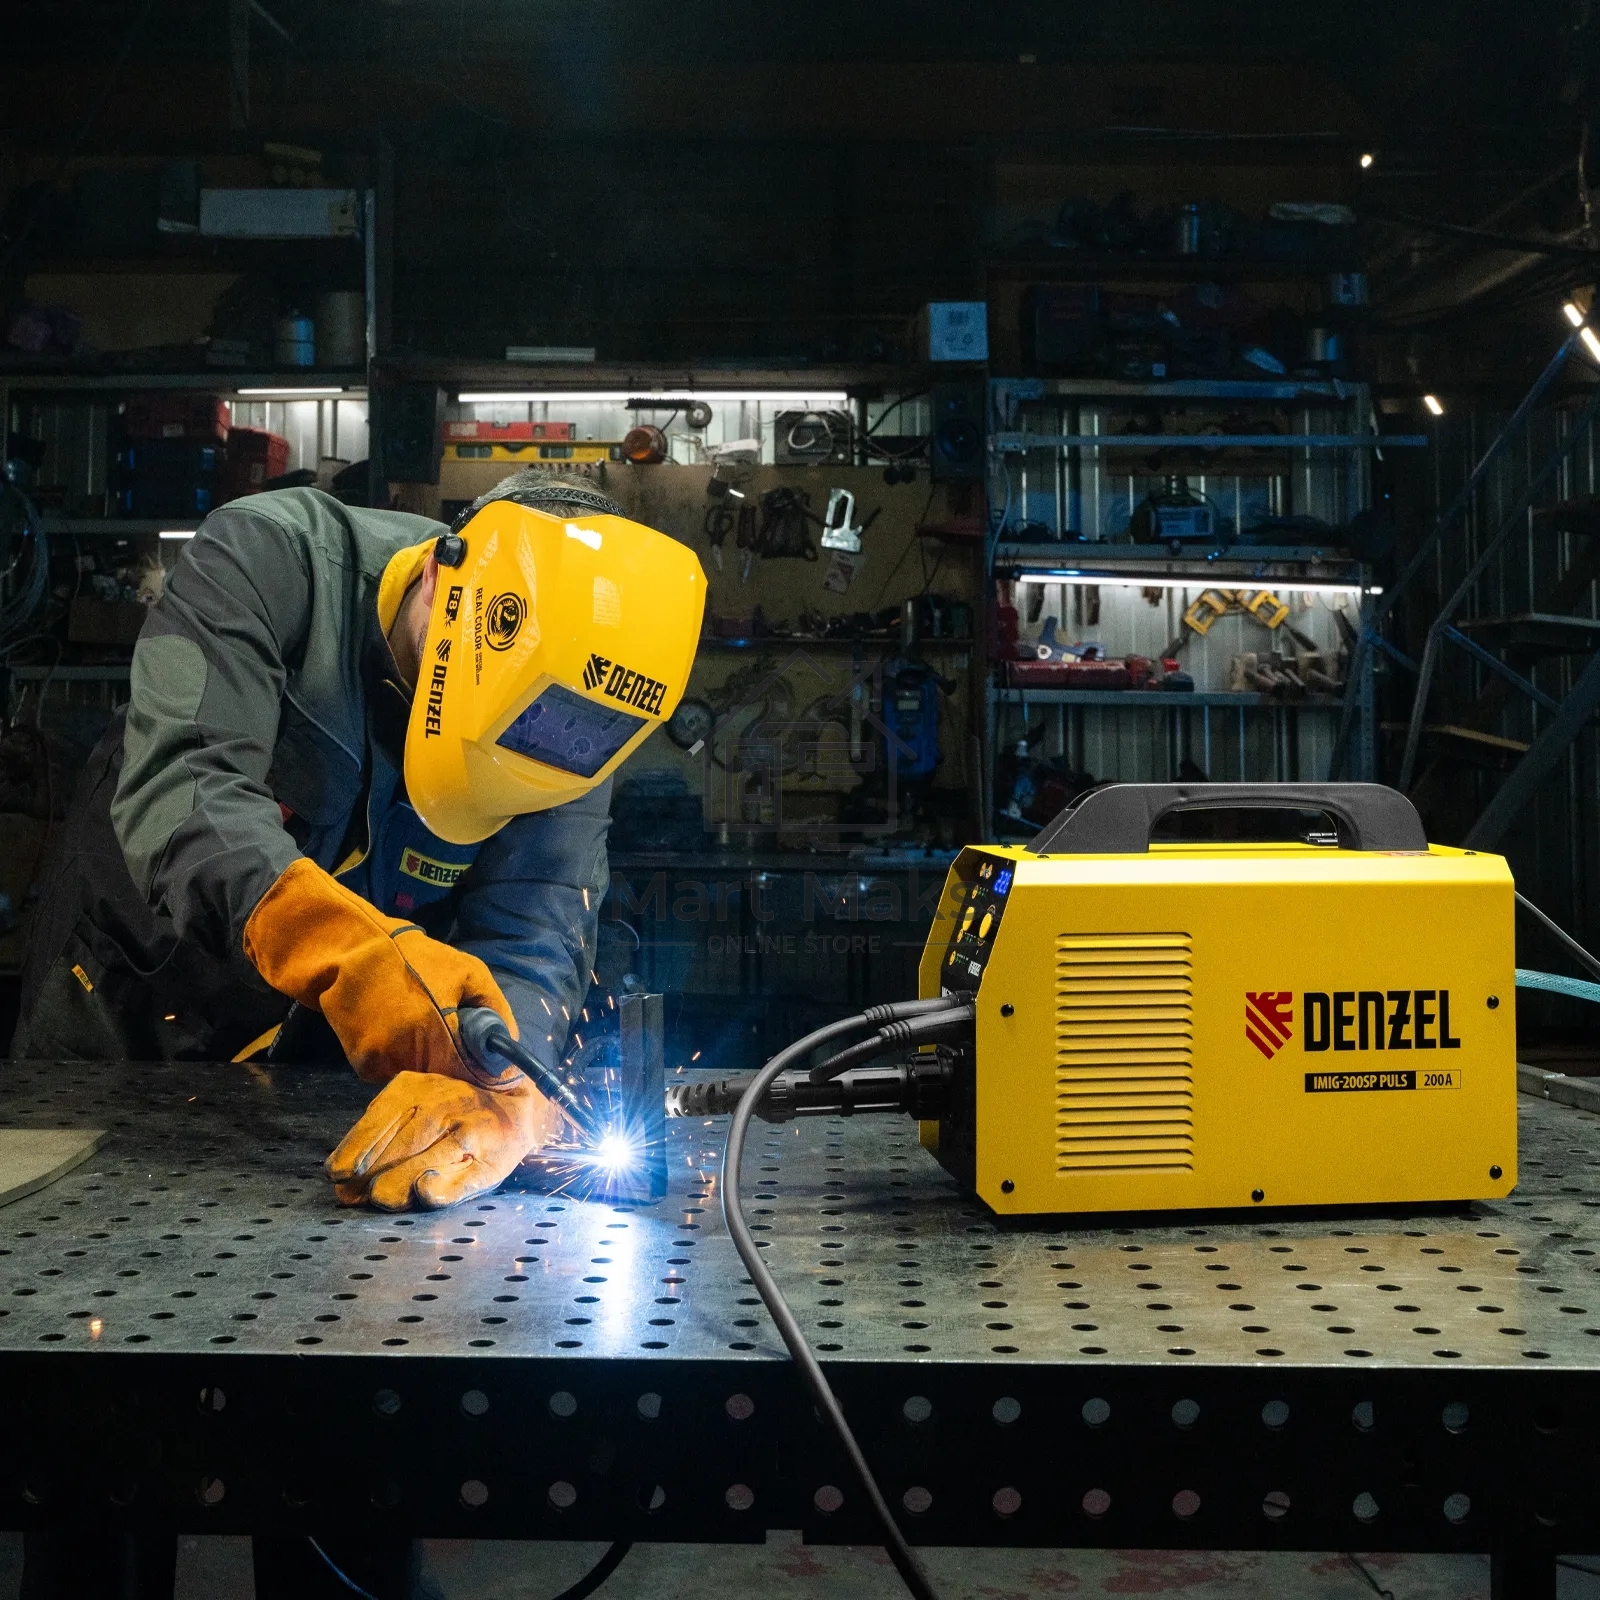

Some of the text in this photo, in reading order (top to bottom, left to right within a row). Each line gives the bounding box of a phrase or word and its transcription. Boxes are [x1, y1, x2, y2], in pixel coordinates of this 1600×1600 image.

[448, 590, 461, 610] F8
[474, 587, 484, 651] REAL COLOR
[425, 665, 447, 739] DENZEL
[604, 664, 668, 716] DENZEL
[419, 861, 465, 883] DENZE
[1303, 990, 1461, 1052] DENZEL
[1313, 1073, 1453, 1090] IMIG-200SP PULS 200A
